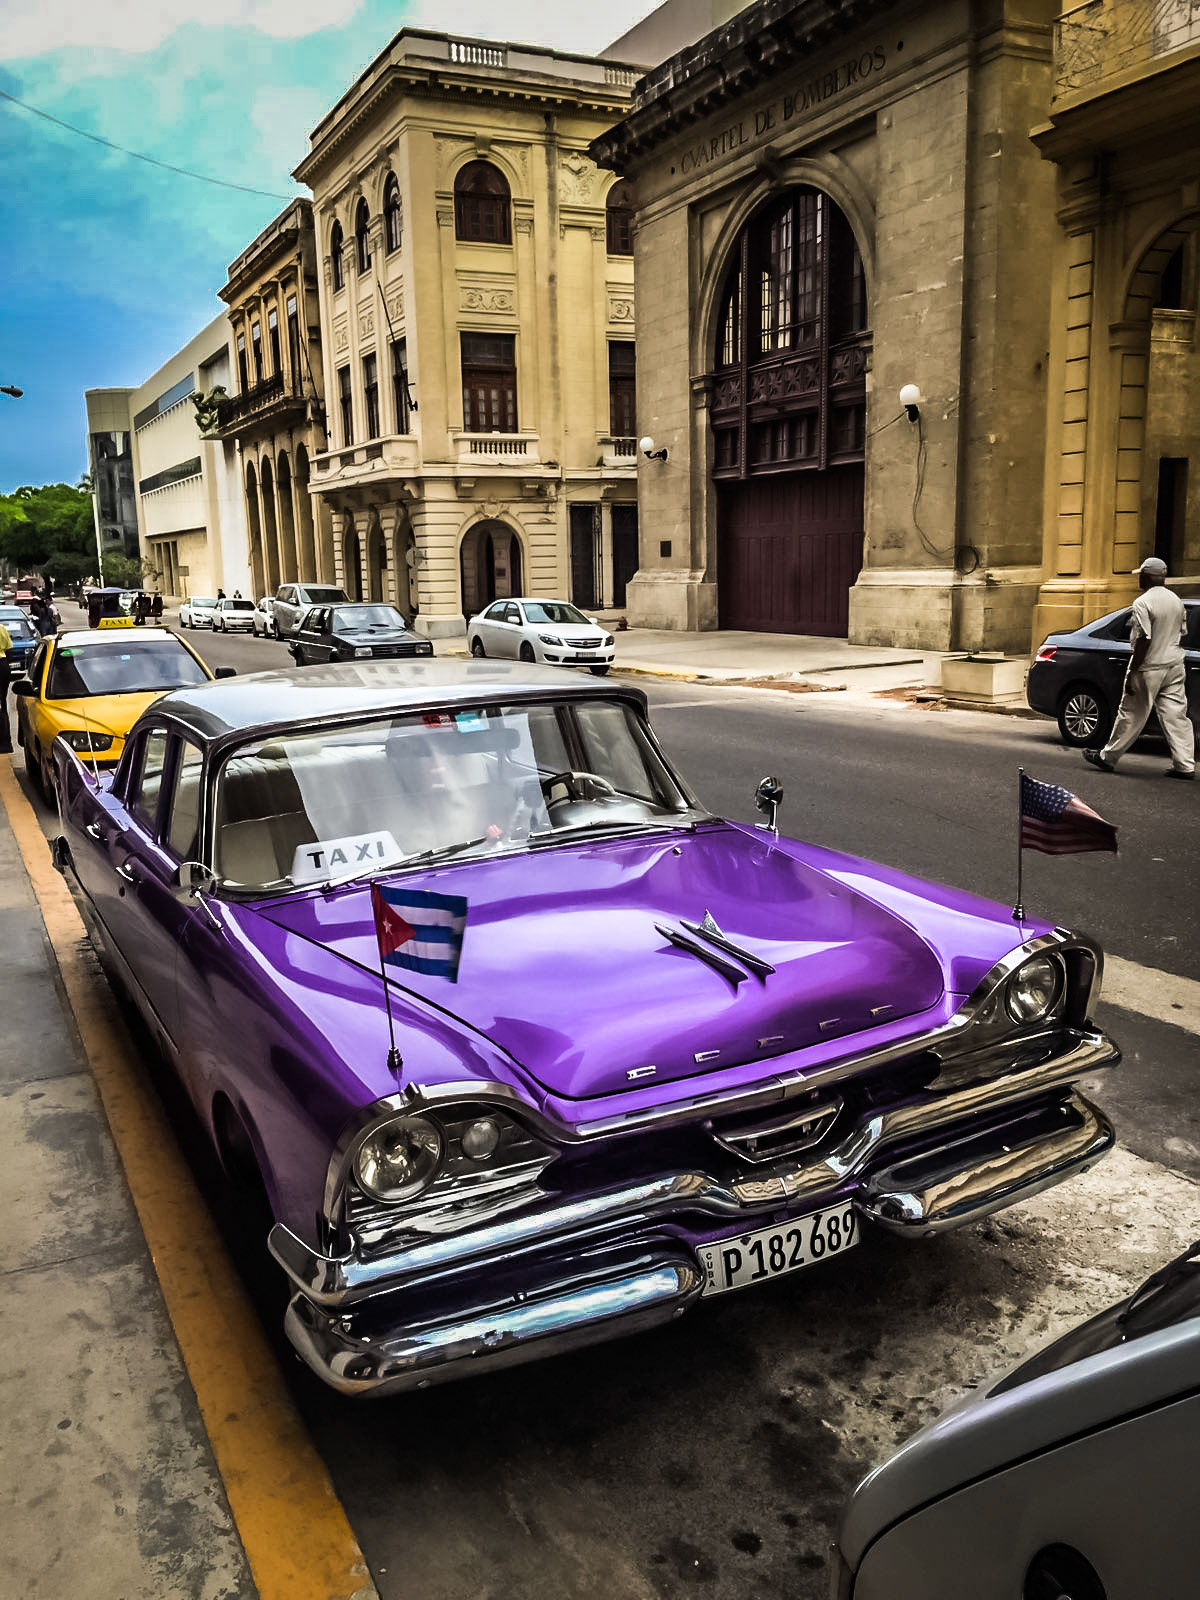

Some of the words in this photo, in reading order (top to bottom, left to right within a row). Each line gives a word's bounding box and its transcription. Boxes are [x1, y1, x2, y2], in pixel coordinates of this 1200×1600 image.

[755, 109, 776, 136] DE
[783, 45, 886, 121] BOMBEROS
[104, 618, 128, 626] TAXI
[307, 841, 385, 869] TAXI
[705, 1252, 716, 1287] CUBA
